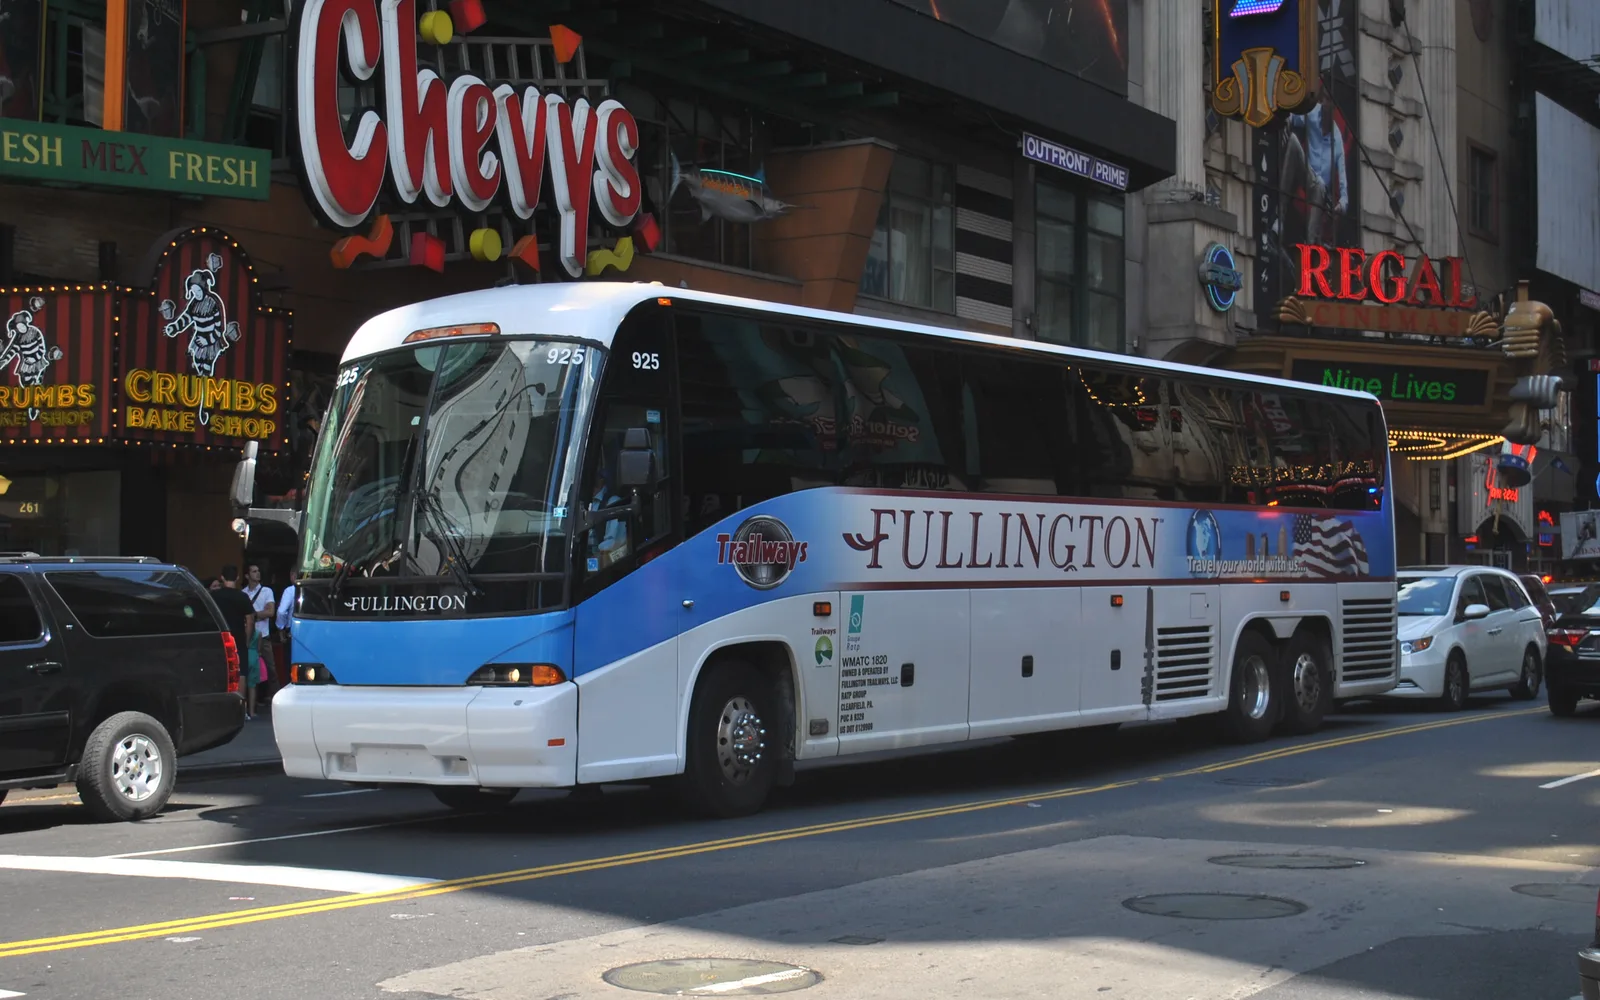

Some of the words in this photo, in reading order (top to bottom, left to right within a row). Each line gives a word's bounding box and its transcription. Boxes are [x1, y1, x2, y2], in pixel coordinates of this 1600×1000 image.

[297, 0, 641, 278] Chevys
[81, 139, 148, 176] MEX
[169, 151, 258, 188] FRESH
[1027, 137, 1090, 174] OUTFRONT
[1095, 161, 1126, 187] PRIME
[1296, 243, 1476, 308] REGAL
[1314, 303, 1461, 335] CINEMAS
[546, 348, 584, 365] 925
[632, 352, 660, 370] 925
[336, 367, 359, 390] 925
[1322, 368, 1383, 396] Nine
[1391, 372, 1456, 400] Lives
[125, 368, 278, 415] CRUMBS
[39, 410, 95, 427] SHOP
[126, 405, 195, 433] BAKE
[209, 413, 276, 440] SHOP
[19, 503, 39, 514] 261
[842, 508, 1160, 572] FULLINGTON
[716, 533, 808, 572] Trailways
[1187, 556, 1216, 573] Travel
[1215, 560, 1238, 578] your
[1240, 556, 1265, 573] world
[1267, 556, 1287, 573] with
[344, 594, 467, 612] FULLINGTON
[811, 628, 836, 636] Trailways
[846, 643, 861, 652] Ratp
[842, 656, 870, 667] WMATC
[872, 655, 888, 665] 1820
[842, 668, 857, 677] OWNED
[862, 667, 882, 675] OPERATED
[883, 666, 889, 674] BY
[841, 679, 866, 689] FULLINGTON
[841, 691, 852, 701] RATP
[852, 690, 867, 699] GROUP
[840, 725, 846, 734] US
[846, 724, 855, 733] DOT
